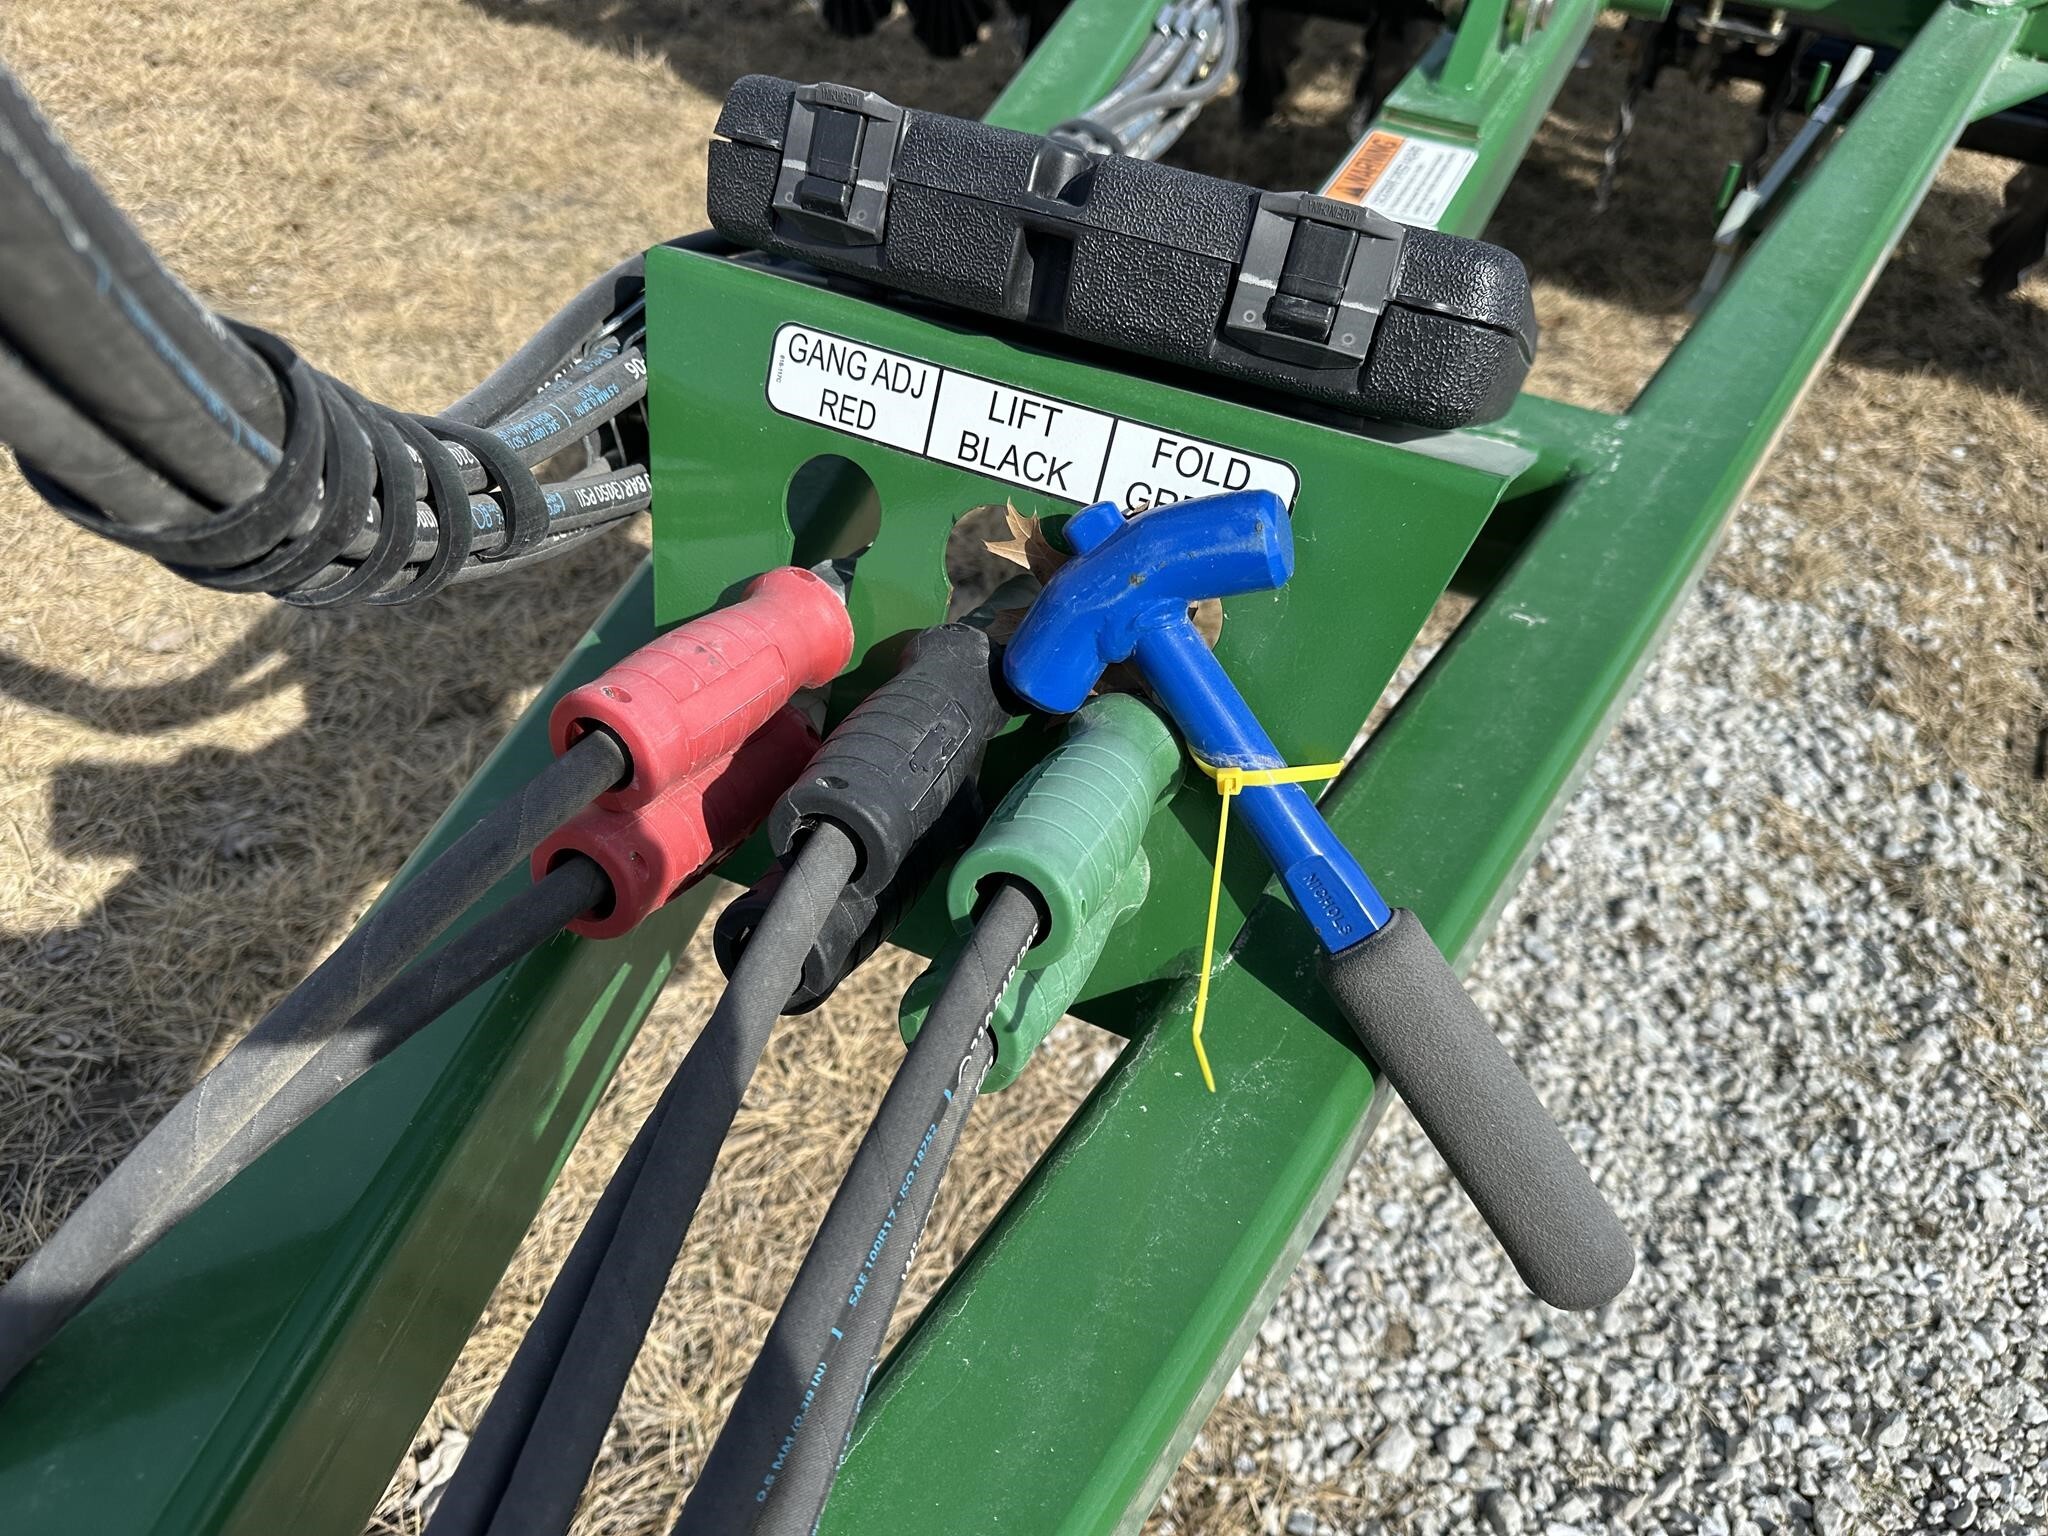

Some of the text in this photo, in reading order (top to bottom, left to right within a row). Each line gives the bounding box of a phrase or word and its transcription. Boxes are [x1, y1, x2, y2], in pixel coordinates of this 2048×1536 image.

[1346, 139, 1397, 187] WARNING
[788, 333, 928, 399] GANG ADJ
[819, 388, 876, 431] RED
[988, 390, 1064, 437] LIFT
[957, 430, 1074, 491] BLACK
[1151, 437, 1251, 491] FOLD
[574, 488, 597, 508] PSI)
[594, 481, 625, 503] (3050
[621, 475, 647, 498] BAR
[1302, 873, 1353, 936] NICHOLS
[847, 1272, 871, 1307] SAE
[863, 1208, 899, 1270] 100R17
[897, 1170, 917, 1199] ISO
[911, 1123, 939, 1168] 18752
[770, 1434, 796, 1472] MM
[809, 1361, 829, 1387] IN)
